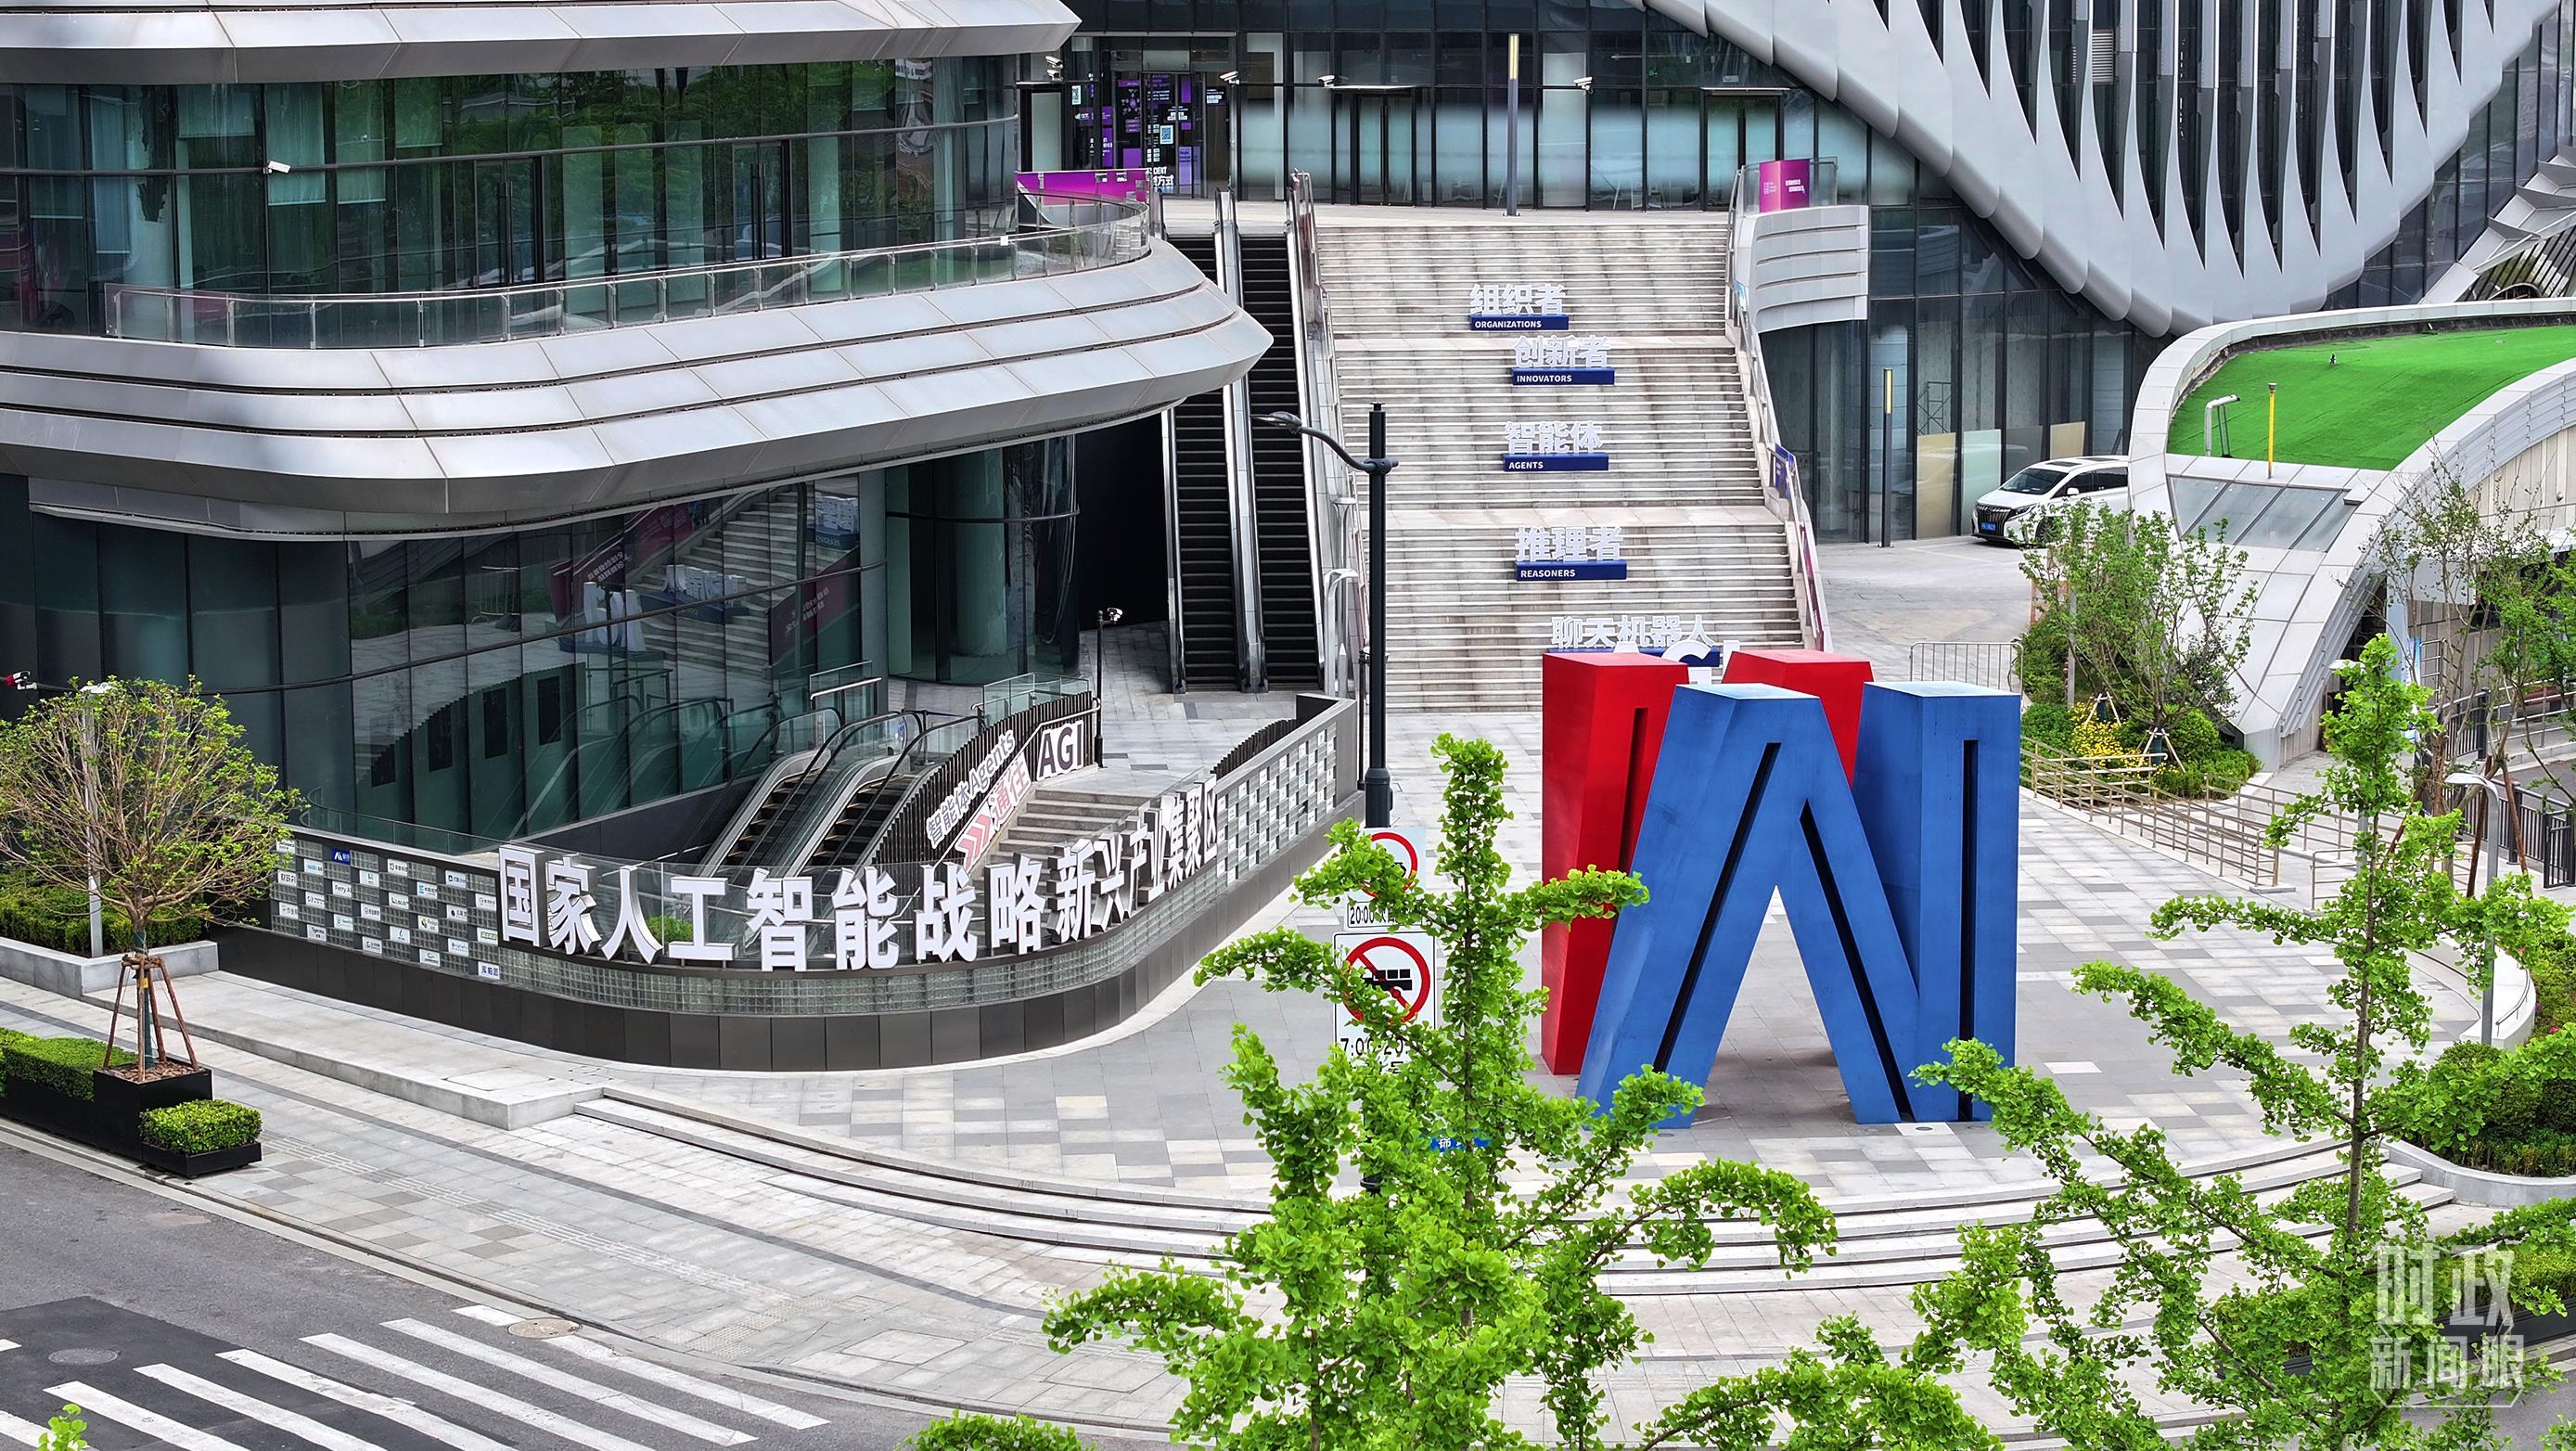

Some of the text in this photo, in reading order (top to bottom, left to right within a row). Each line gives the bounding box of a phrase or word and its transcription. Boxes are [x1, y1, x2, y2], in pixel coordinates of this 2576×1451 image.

[1470, 284, 1567, 315] 组织者
[1475, 320, 1542, 328] ORGANIZATIONS
[1514, 335, 1610, 367] 创新者
[1505, 421, 1603, 455] 智能体
[1515, 526, 1623, 561] 推理者
[1520, 570, 1575, 578] REASONERS
[1551, 614, 1715, 648] 聊天机器人
[1038, 722, 1083, 779] AGI
[990, 756, 1031, 828] 通往
[499, 773, 1218, 972] 国家人工智能战略新兴产业集聚区
